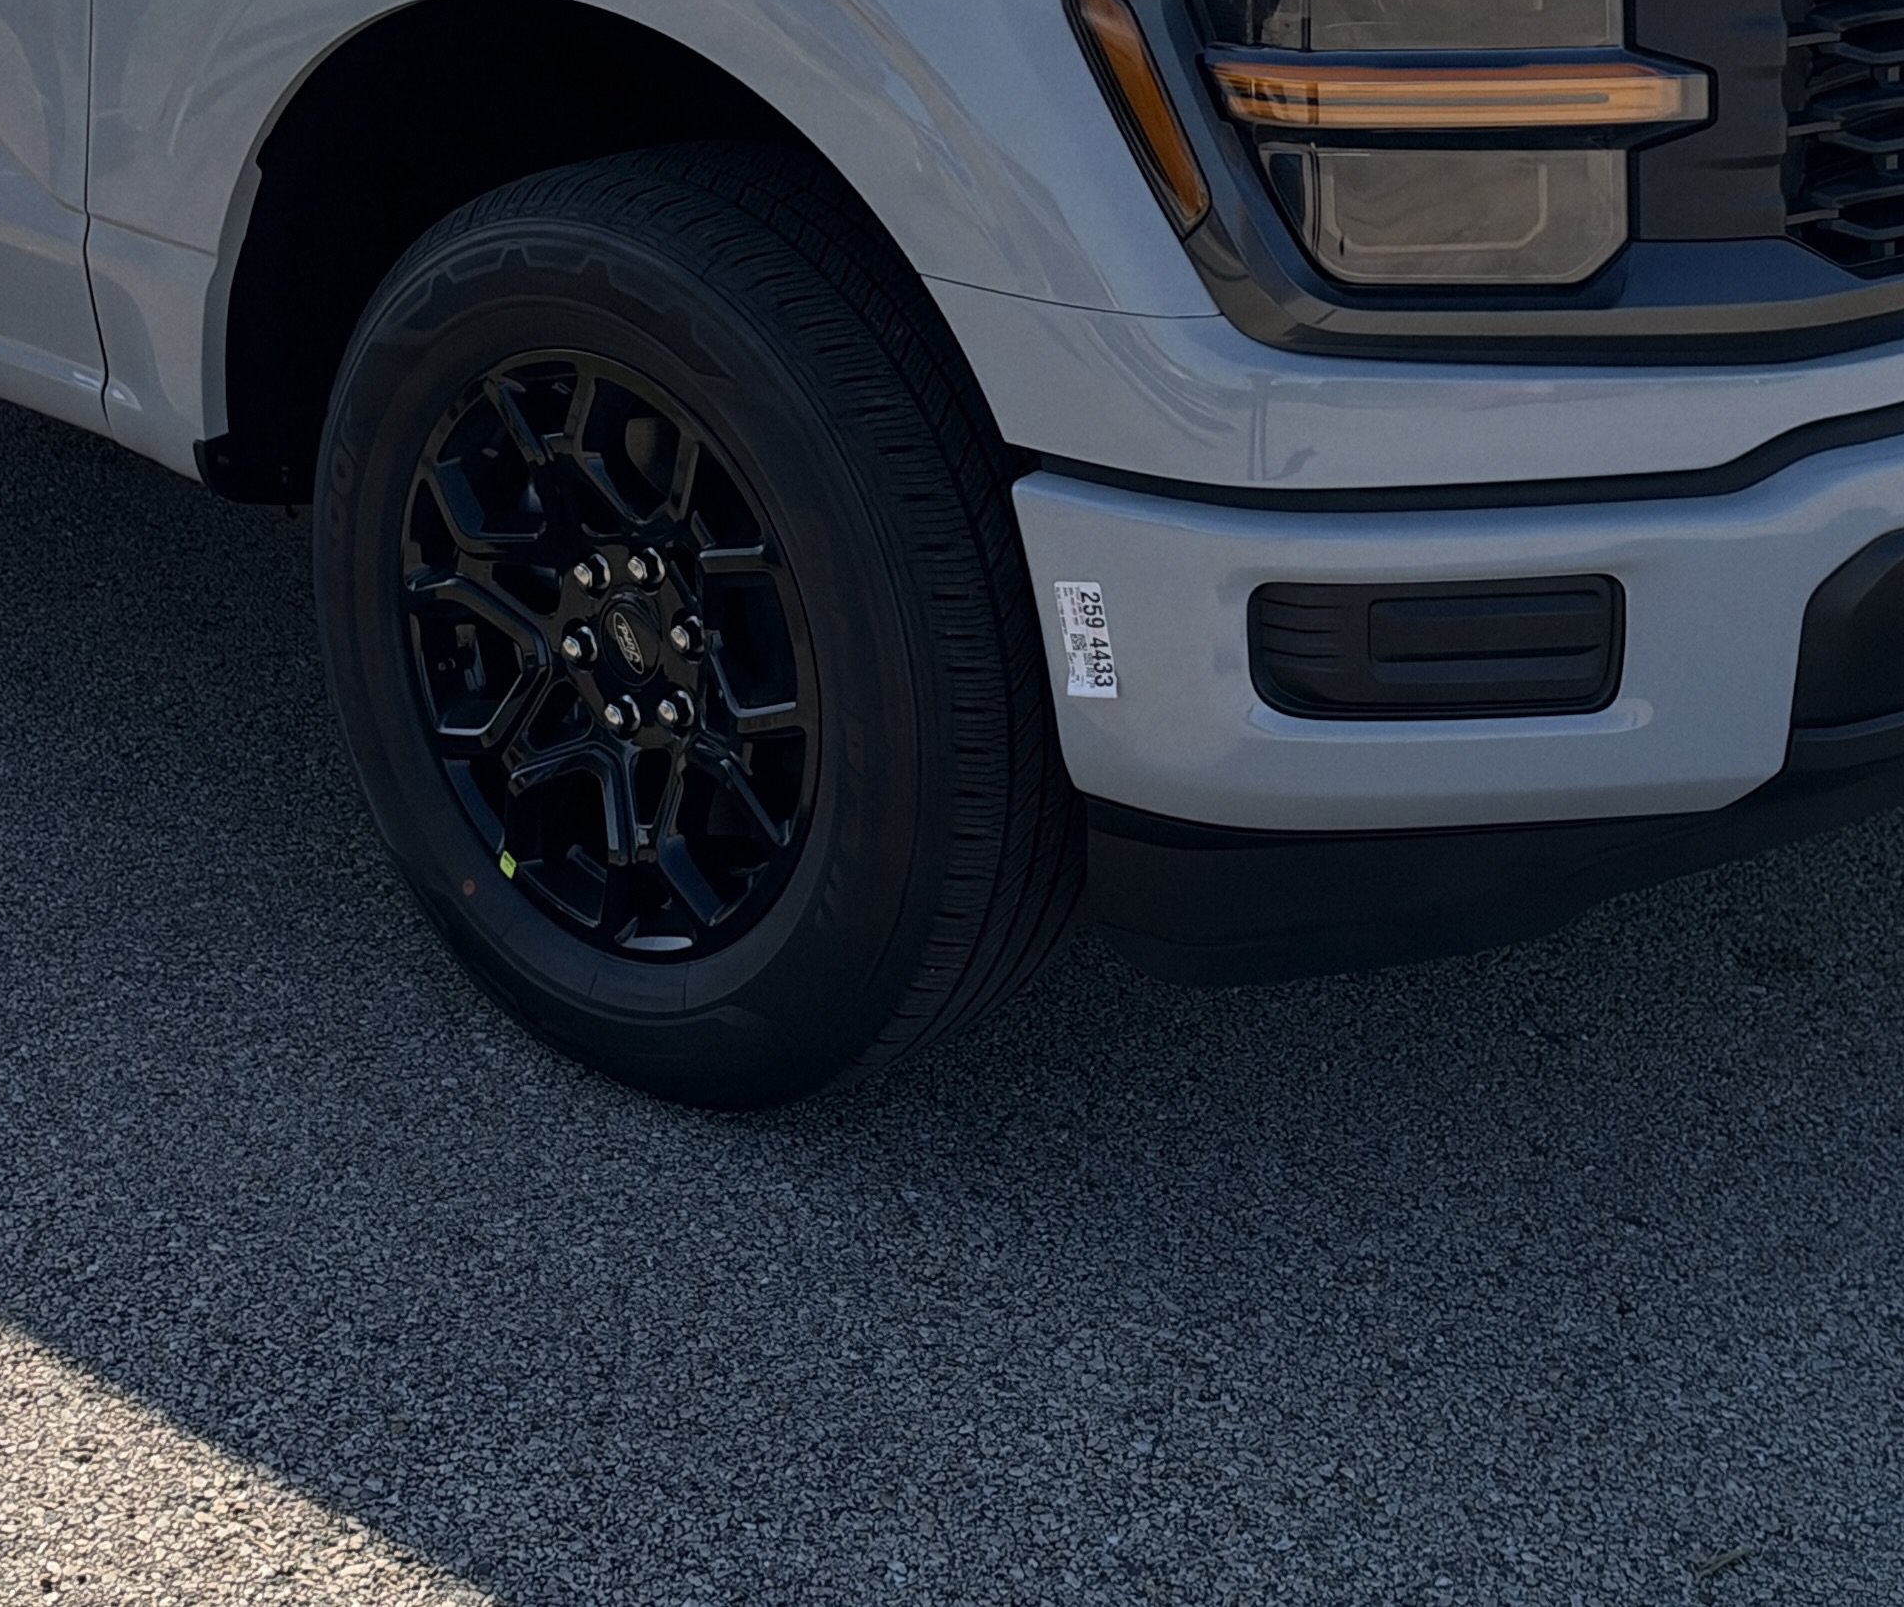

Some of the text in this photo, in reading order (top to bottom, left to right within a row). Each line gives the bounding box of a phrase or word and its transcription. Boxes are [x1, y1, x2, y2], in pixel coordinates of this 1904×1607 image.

[1079, 591, 1106, 630] 259
[615, 622, 642, 663] Ford
[1089, 636, 1115, 688] 4433
